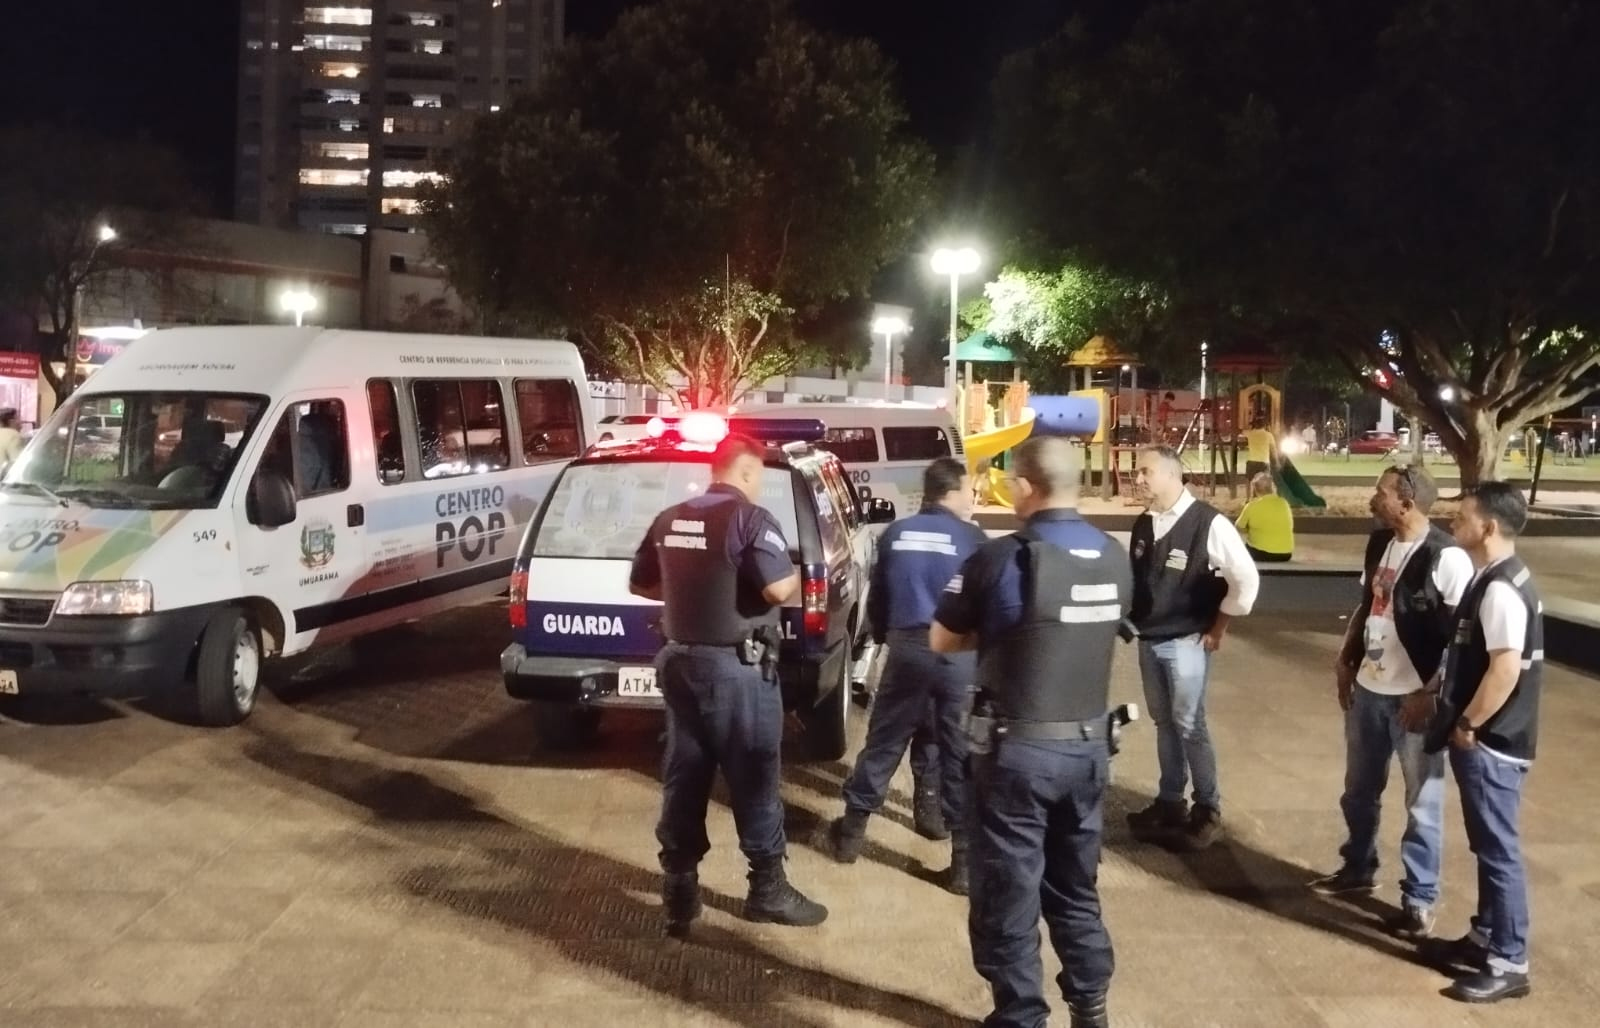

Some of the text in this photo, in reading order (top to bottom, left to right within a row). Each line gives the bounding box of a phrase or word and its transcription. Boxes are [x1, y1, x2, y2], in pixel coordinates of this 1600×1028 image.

[399, 355, 425, 364] CENTRO
[435, 485, 505, 518] CENTRO
[3, 530, 66, 553] OP
[193, 529, 217, 543] 549
[435, 511, 506, 569] POP
[299, 571, 339, 587] UMUARAMA
[543, 613, 625, 636] GUARDA
